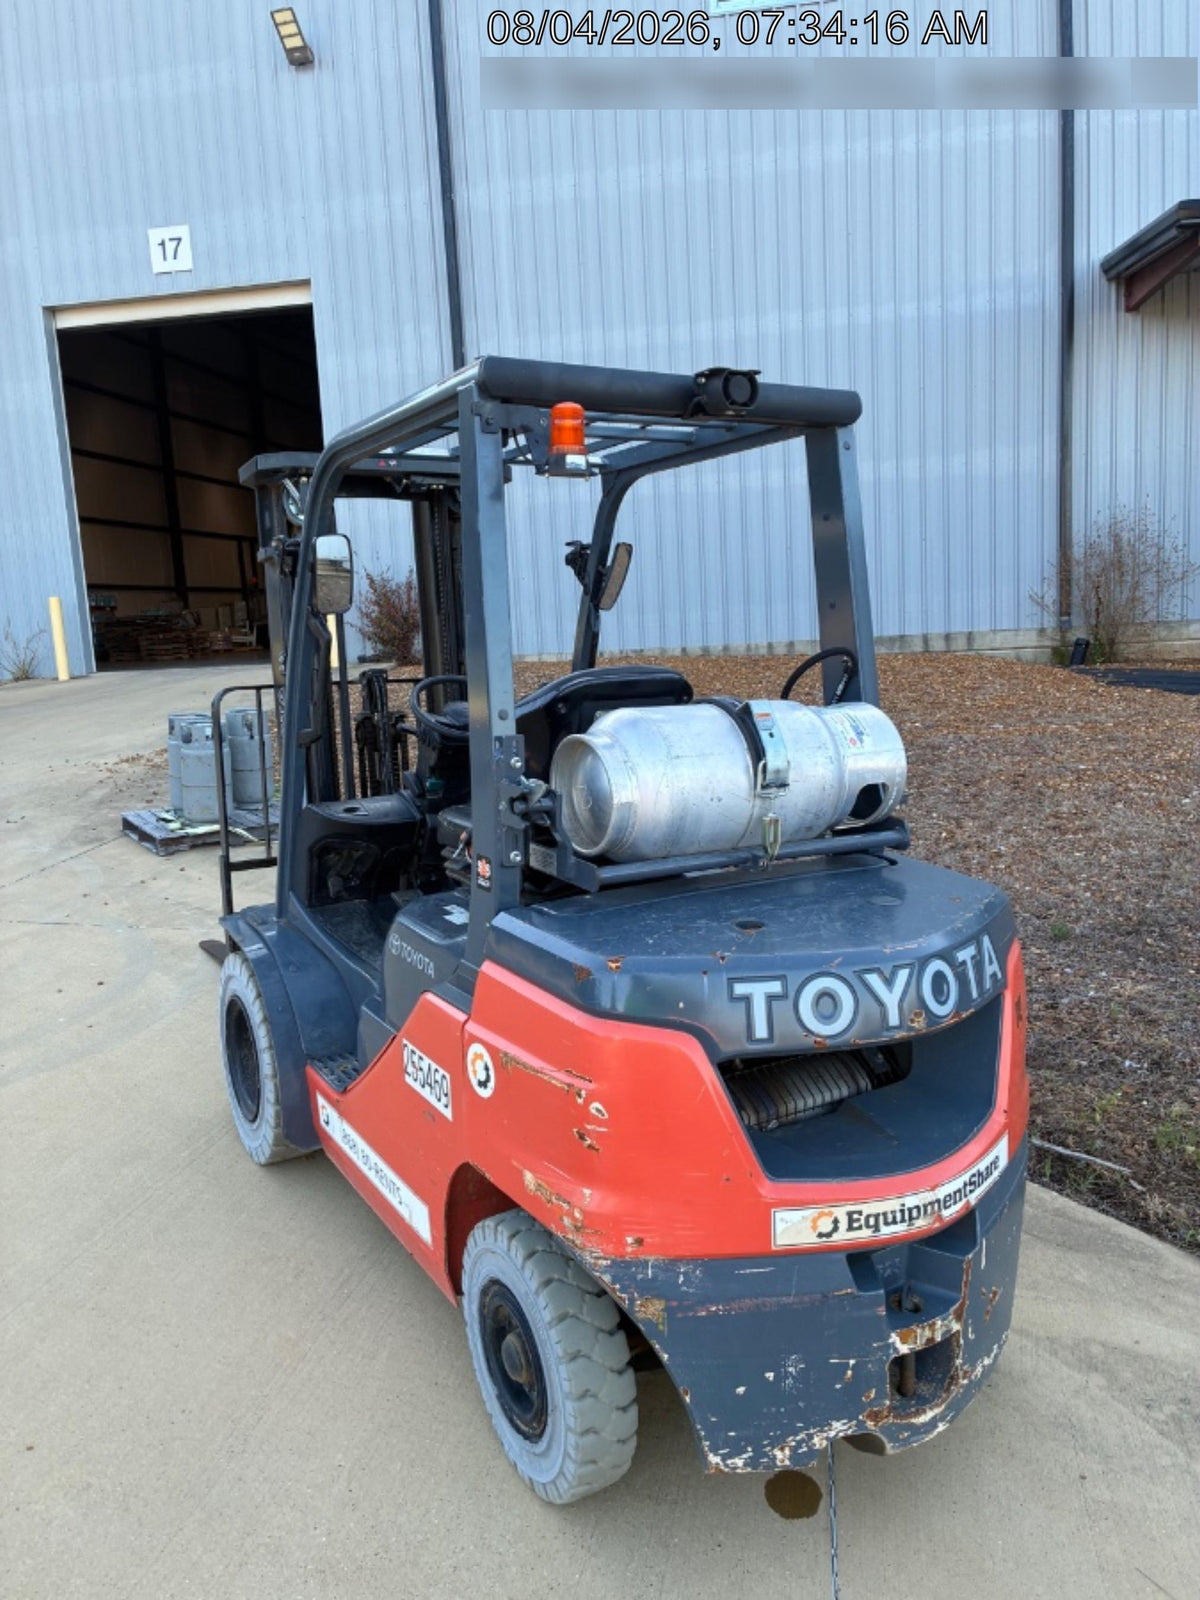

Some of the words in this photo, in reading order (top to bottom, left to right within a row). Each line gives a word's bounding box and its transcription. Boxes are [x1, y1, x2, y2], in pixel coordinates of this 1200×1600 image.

[157, 236, 182, 262] 17
[401, 941, 435, 979] TOYOTA
[732, 933, 1002, 1041] TOYOTA
[403, 1042, 449, 1109] 255469
[844, 1154, 1000, 1233] EquipmentShare
